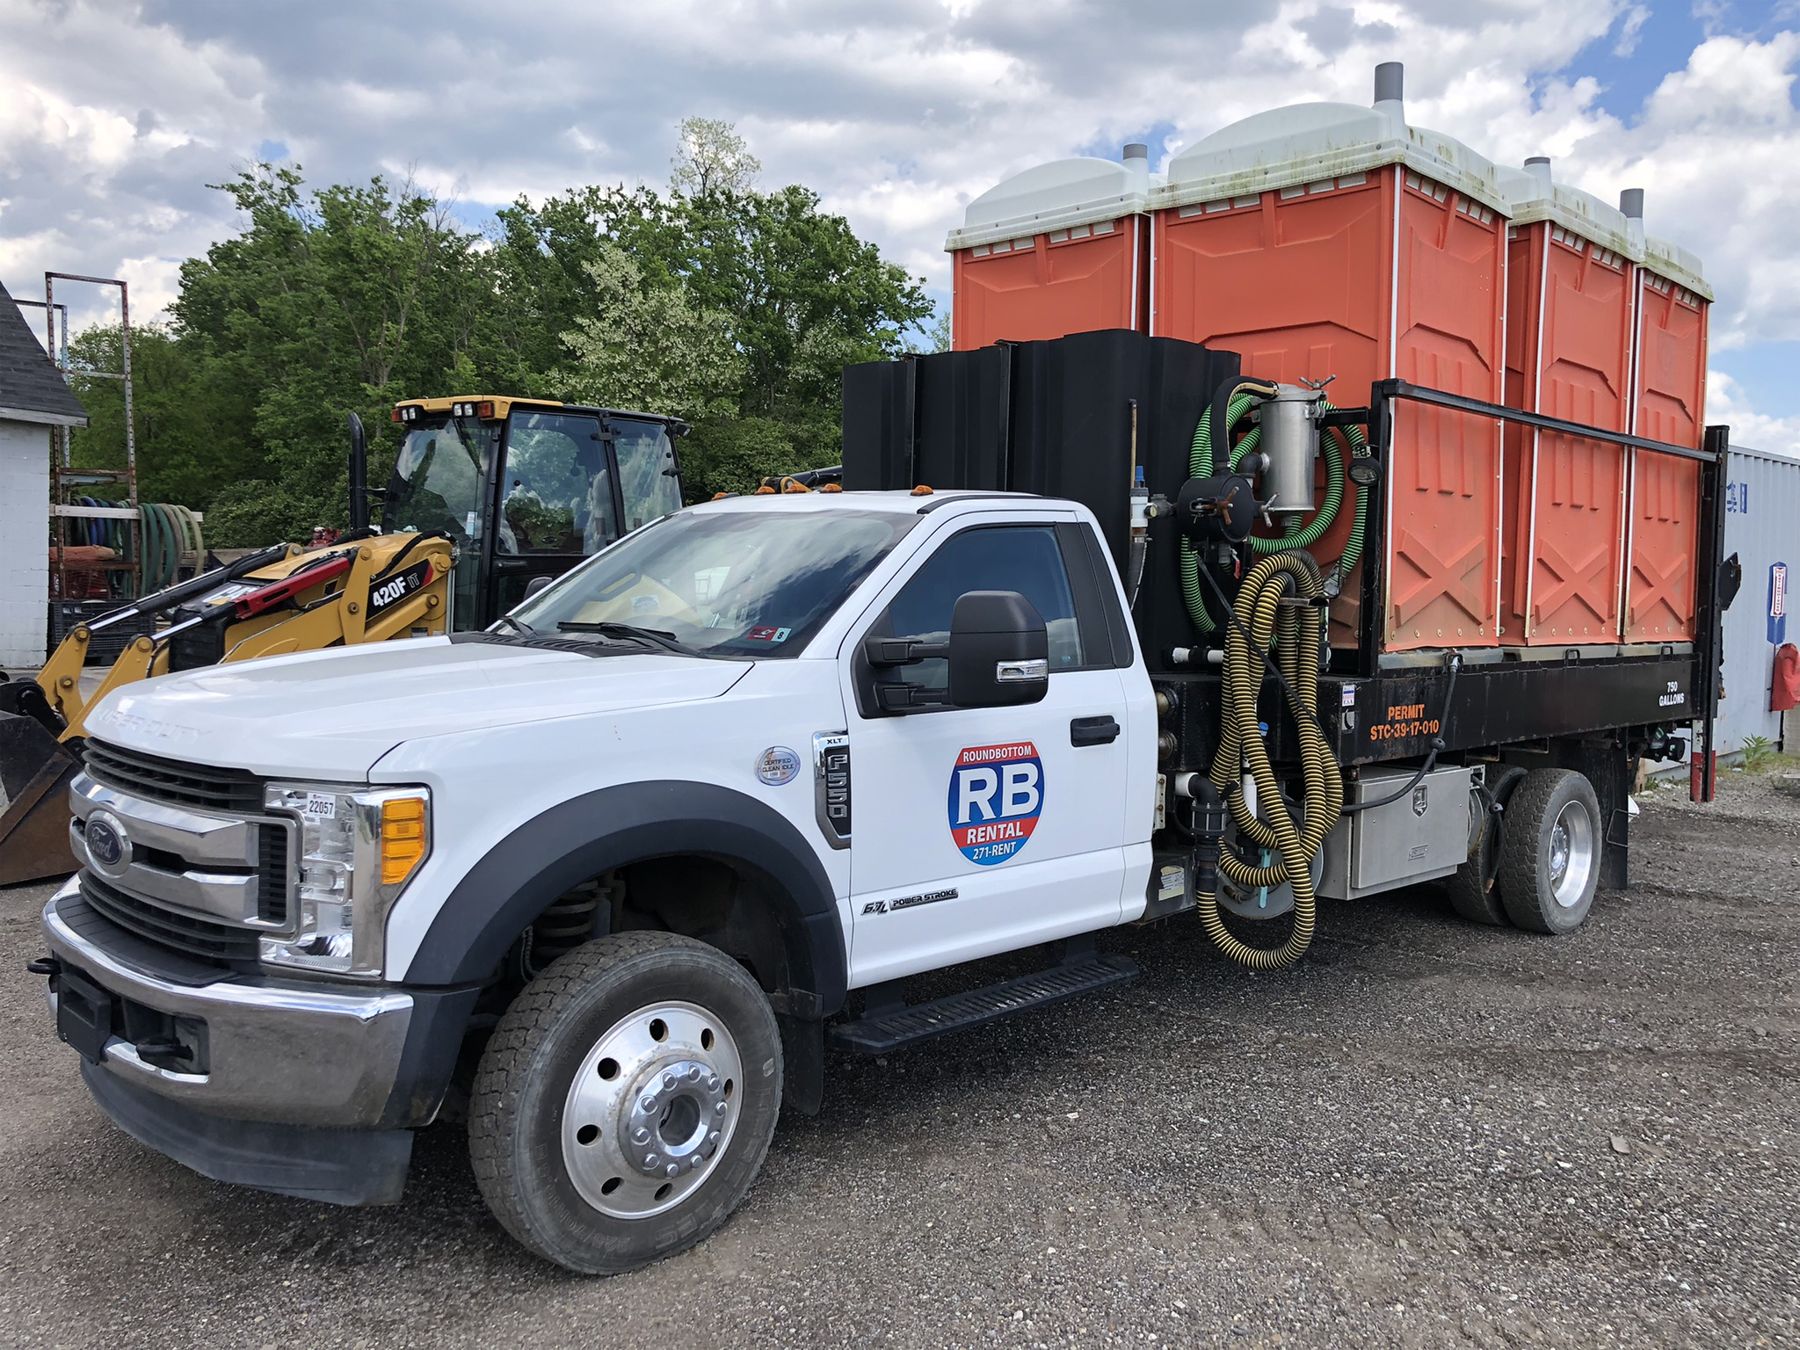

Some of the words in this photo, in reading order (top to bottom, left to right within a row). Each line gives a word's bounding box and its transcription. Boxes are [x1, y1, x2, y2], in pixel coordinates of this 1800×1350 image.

[371, 576, 406, 608] 420F
[1667, 681, 1678, 693] 750
[1659, 692, 1685, 707] GALLONS
[1387, 703, 1425, 721] PERMIT
[1370, 719, 1440, 741] STC-39-17-010
[826, 737, 843, 745] XLT
[764, 758, 792, 767] CERTIFIED
[963, 745, 1032, 763] ROUNDBOTTOM
[956, 762, 1040, 825] RB
[309, 800, 334, 815] 22057
[966, 821, 1024, 845] RENTAL
[90, 826, 112, 859] Ford
[972, 841, 1017, 860] 271-RENT
[892, 895, 923, 907] POWER
[923, 888, 958, 901] STROKE
